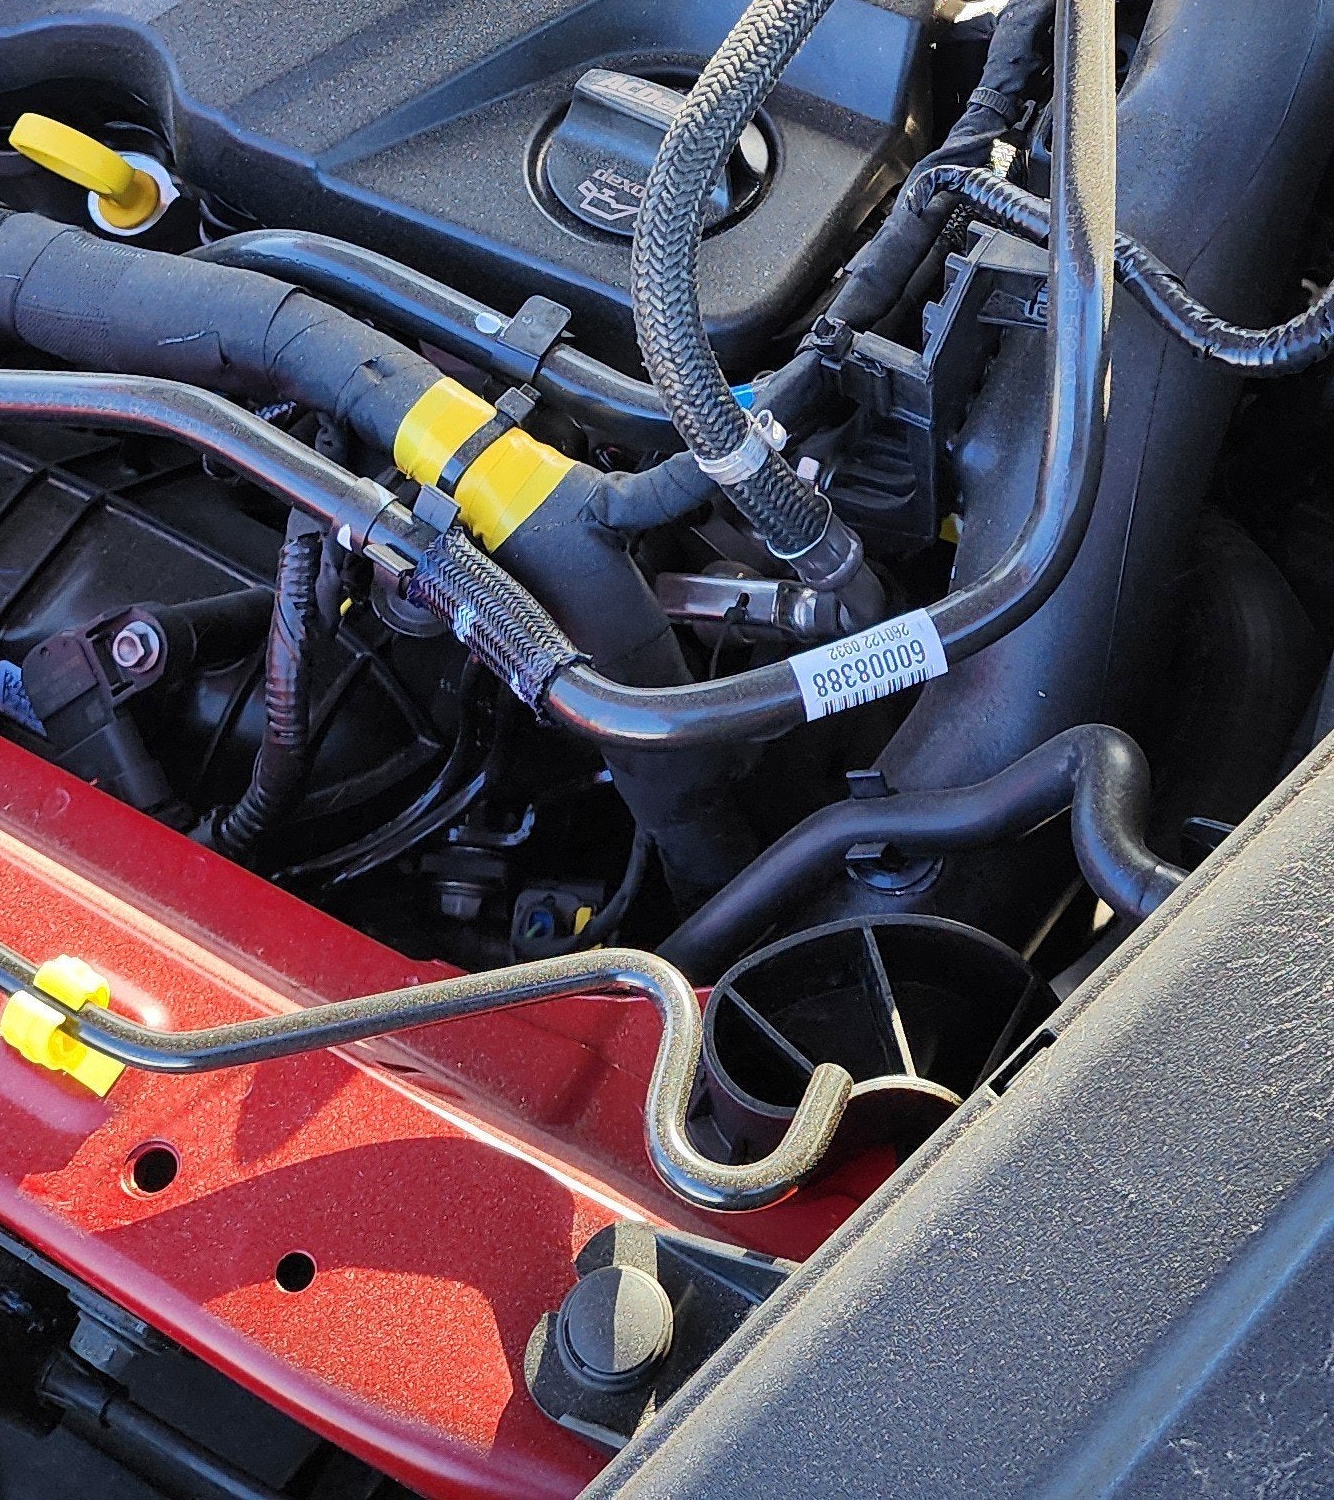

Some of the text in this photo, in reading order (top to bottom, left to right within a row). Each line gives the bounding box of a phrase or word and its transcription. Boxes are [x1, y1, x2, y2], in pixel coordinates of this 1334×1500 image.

[593, 166, 648, 198] dexo
[862, 623, 909, 648] 260122
[812, 639, 926, 697] 60008388
